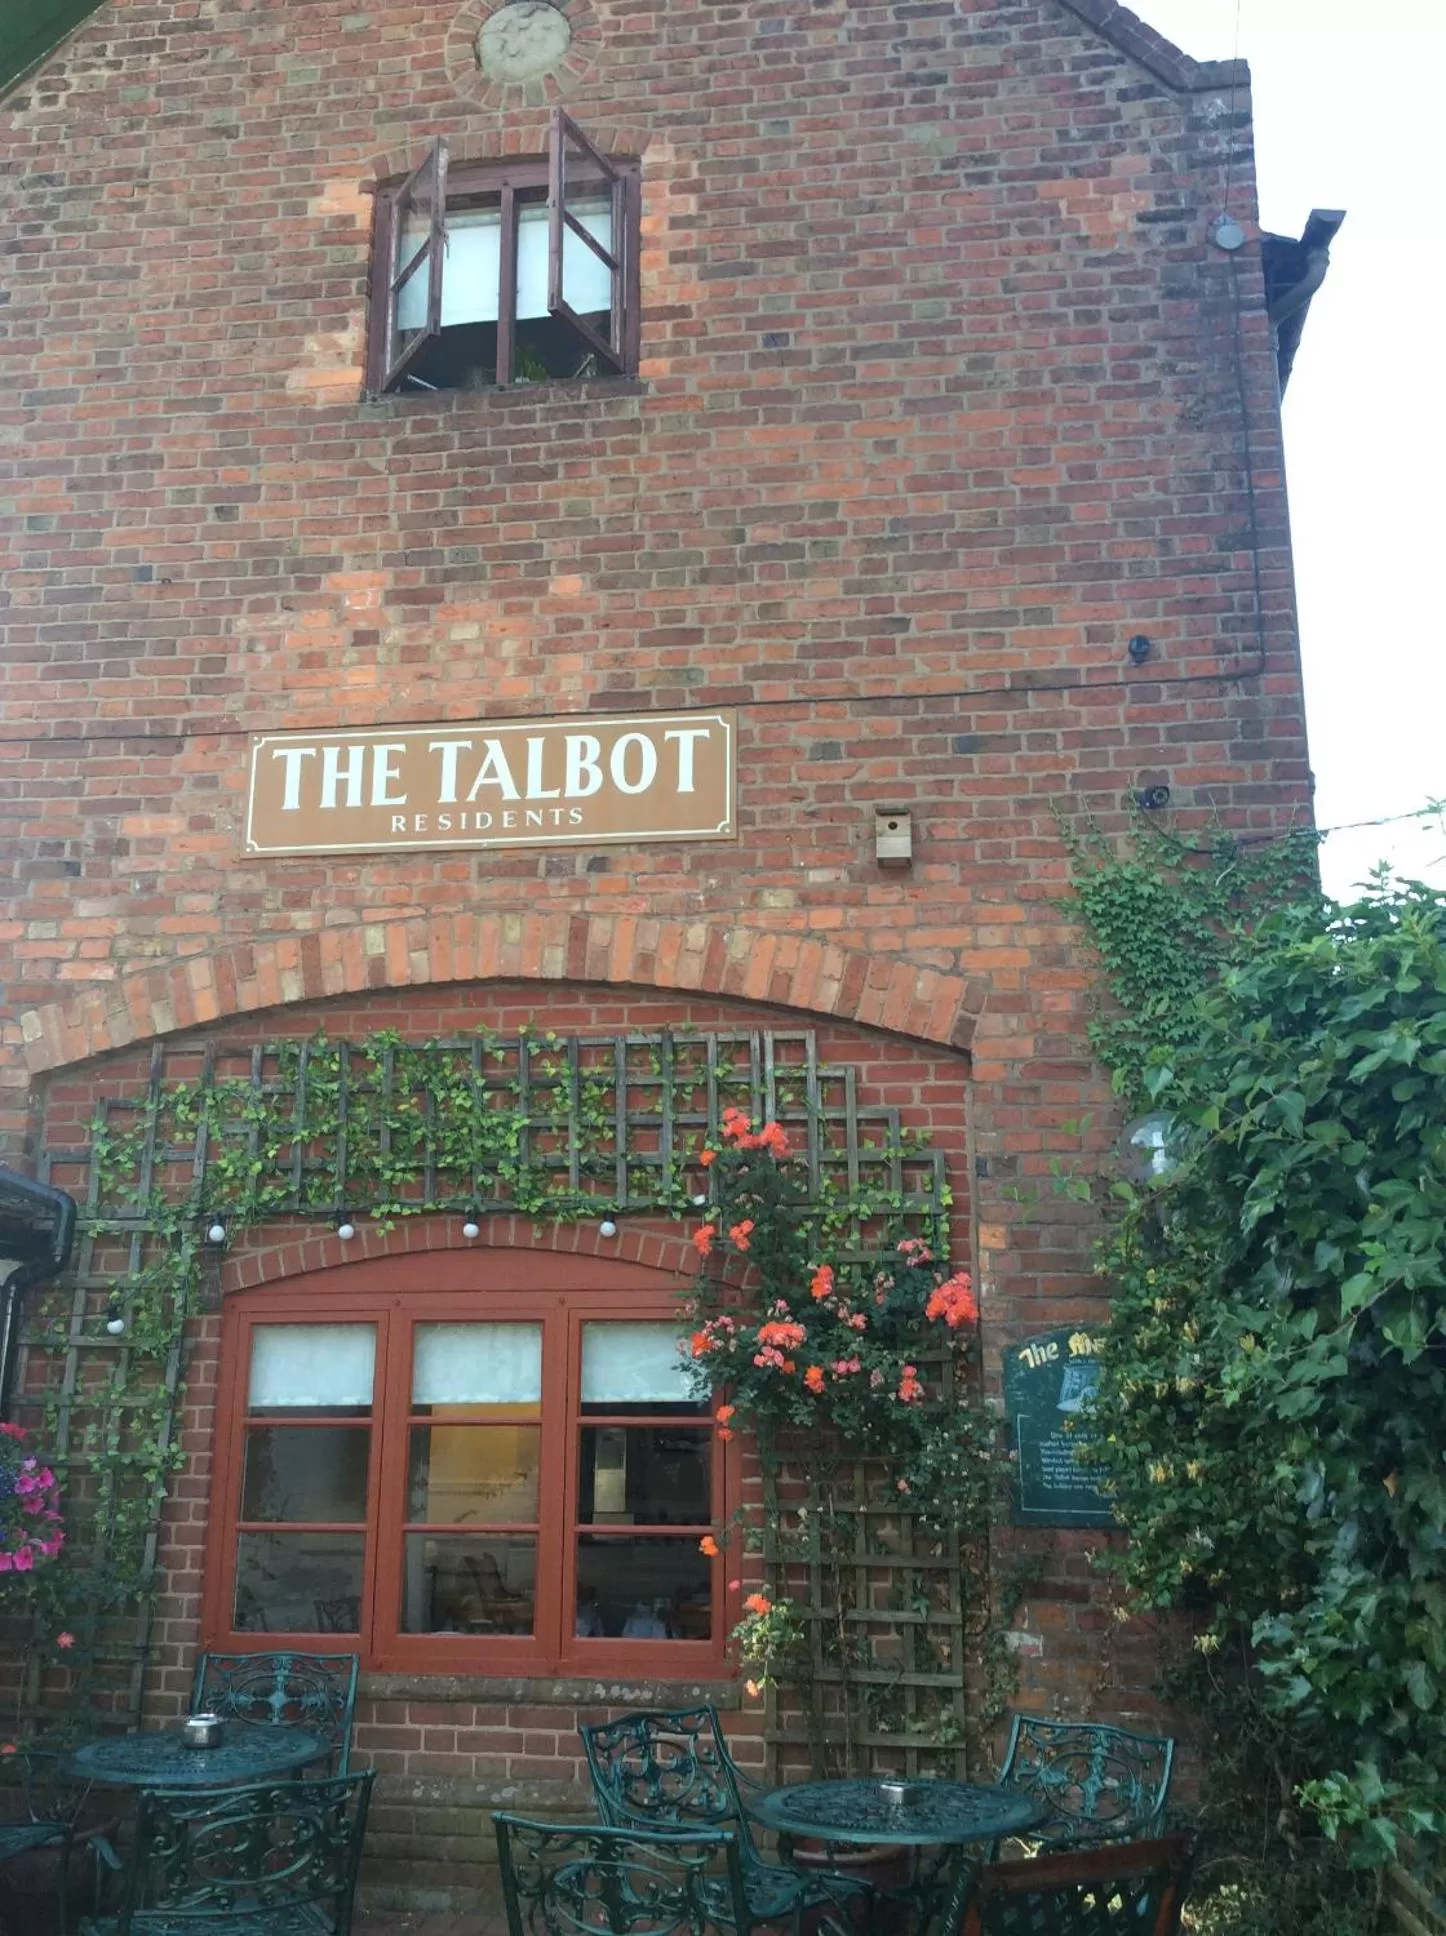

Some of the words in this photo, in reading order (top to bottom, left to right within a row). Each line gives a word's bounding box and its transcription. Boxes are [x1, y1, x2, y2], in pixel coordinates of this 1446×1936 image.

[272, 743, 408, 810] THE
[428, 729, 711, 803] TALBOT
[391, 806, 585, 833] RESIDENTS
[1018, 1341, 1060, 1369] The
